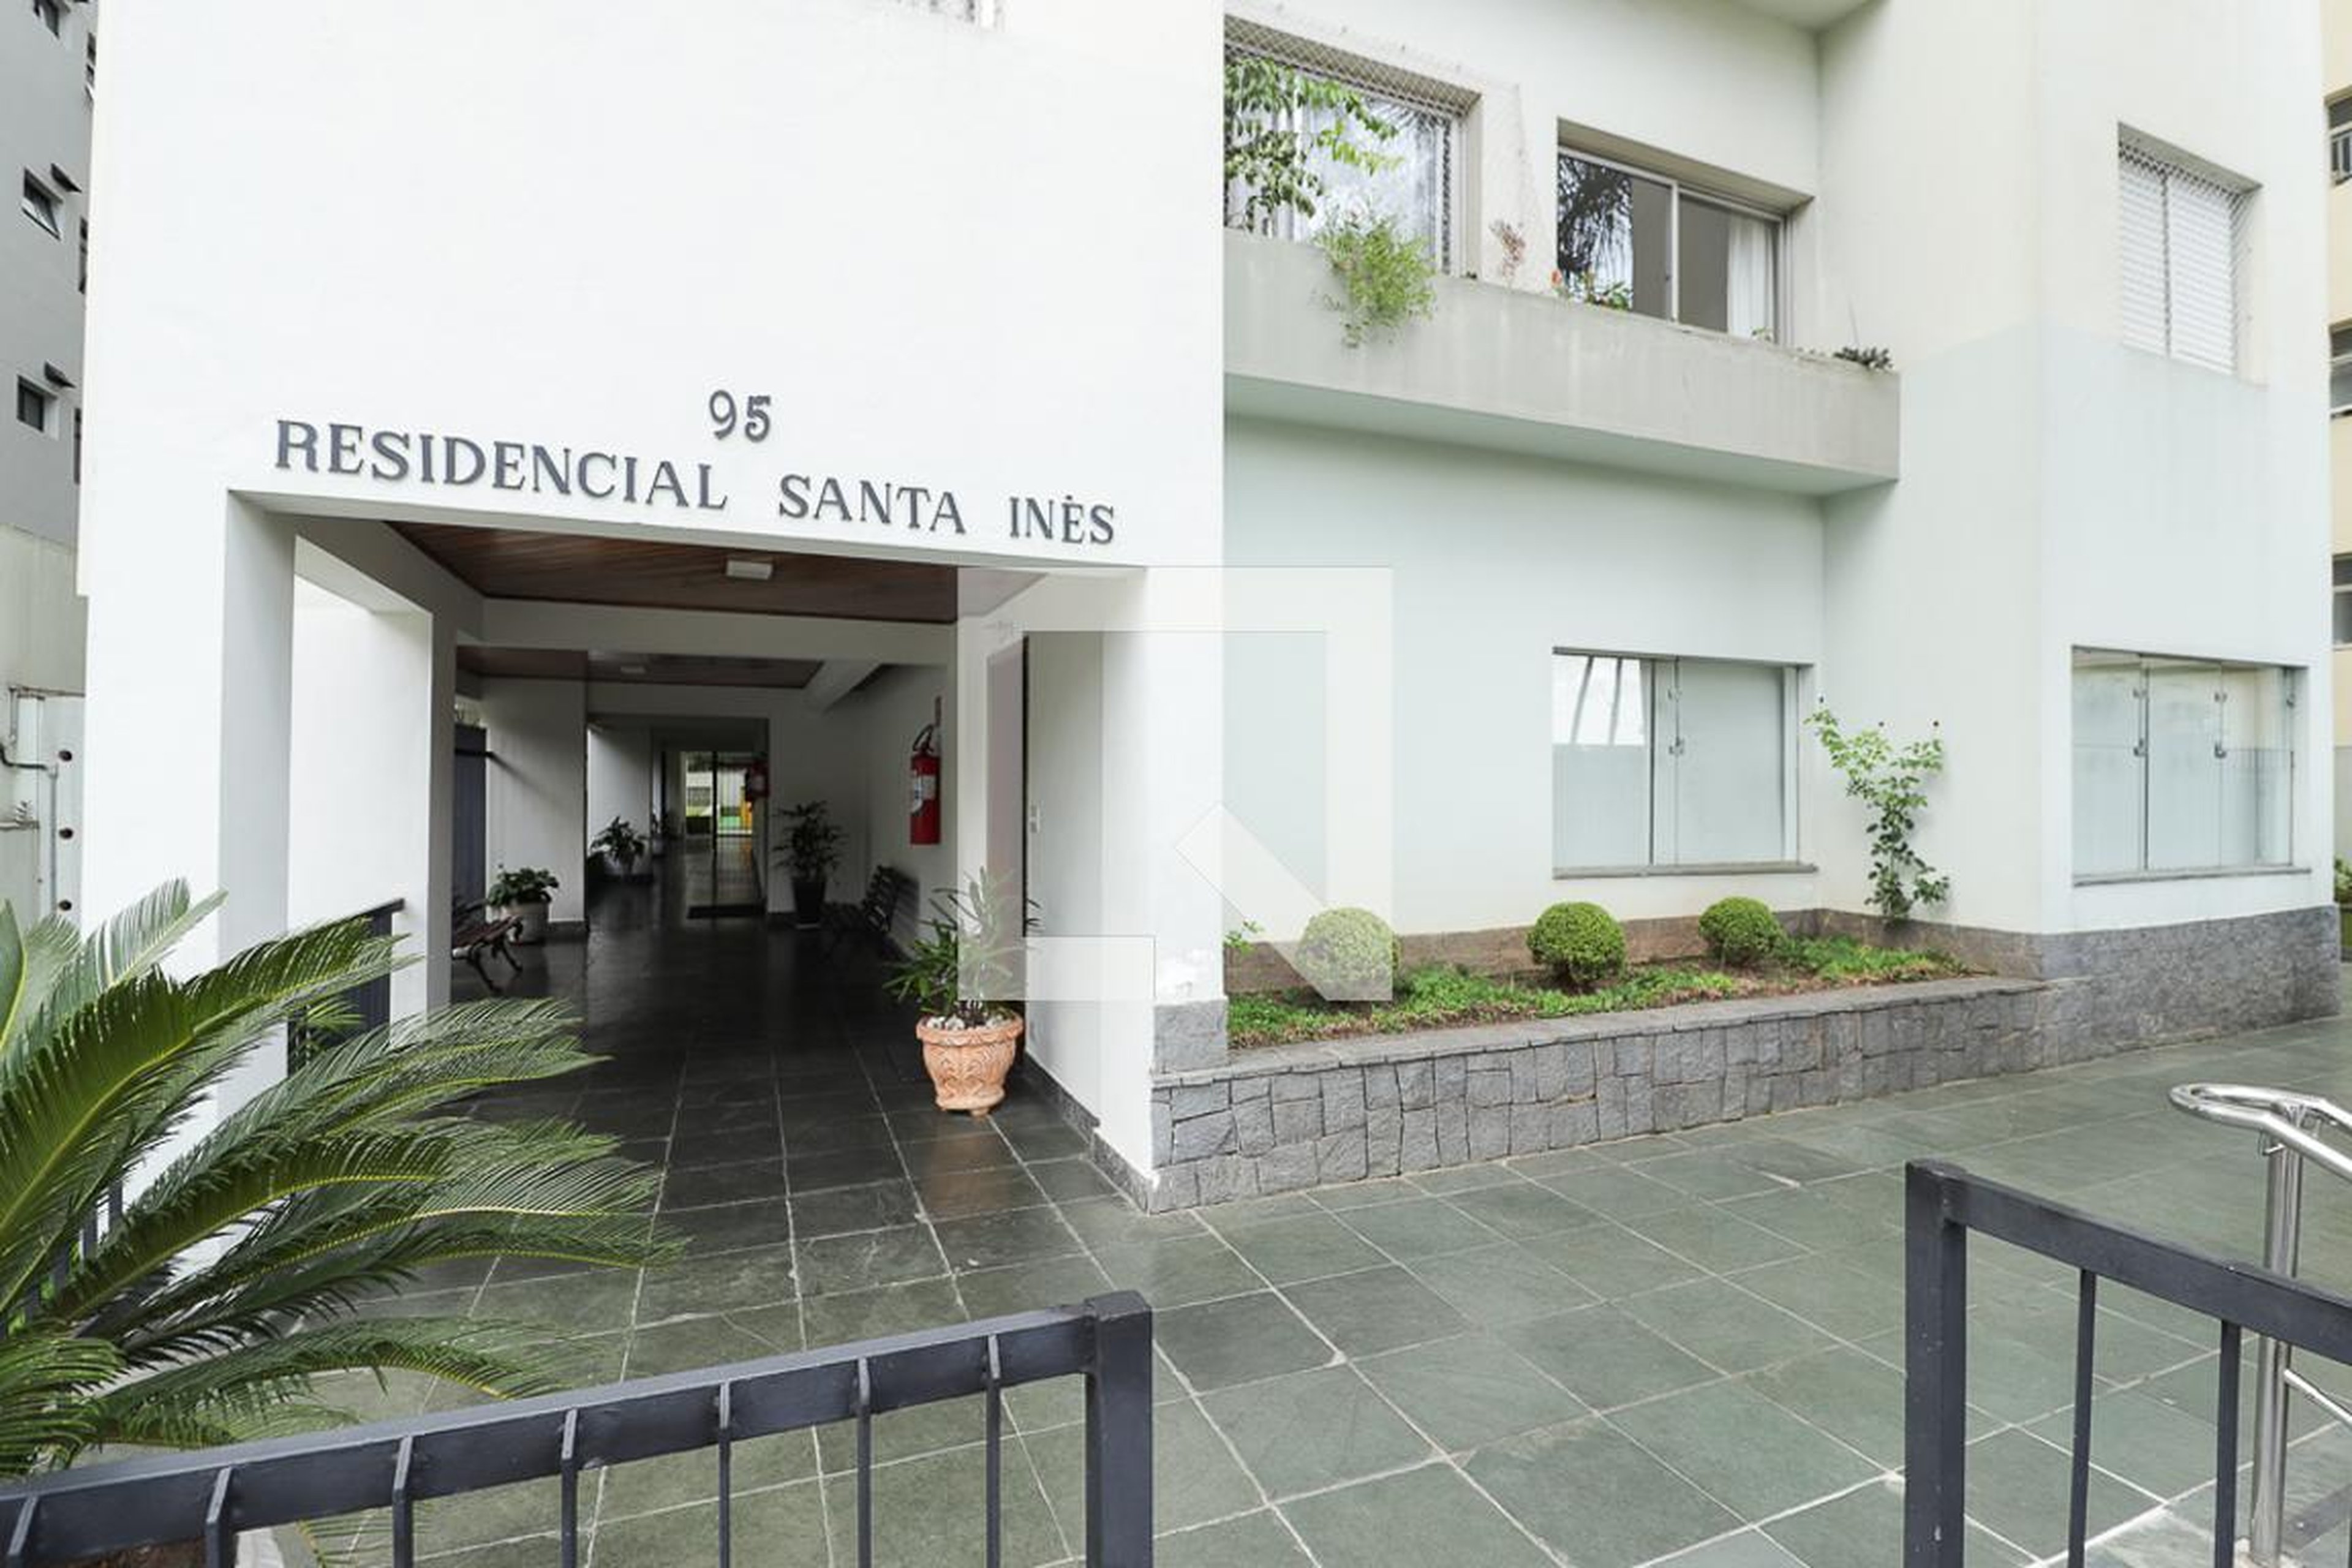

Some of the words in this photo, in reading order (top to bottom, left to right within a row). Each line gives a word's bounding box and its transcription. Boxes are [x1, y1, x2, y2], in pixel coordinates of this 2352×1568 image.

[708, 389, 772, 443] 95
[276, 420, 728, 510] RESIDENCIAL
[778, 474, 965, 535] SANTA
